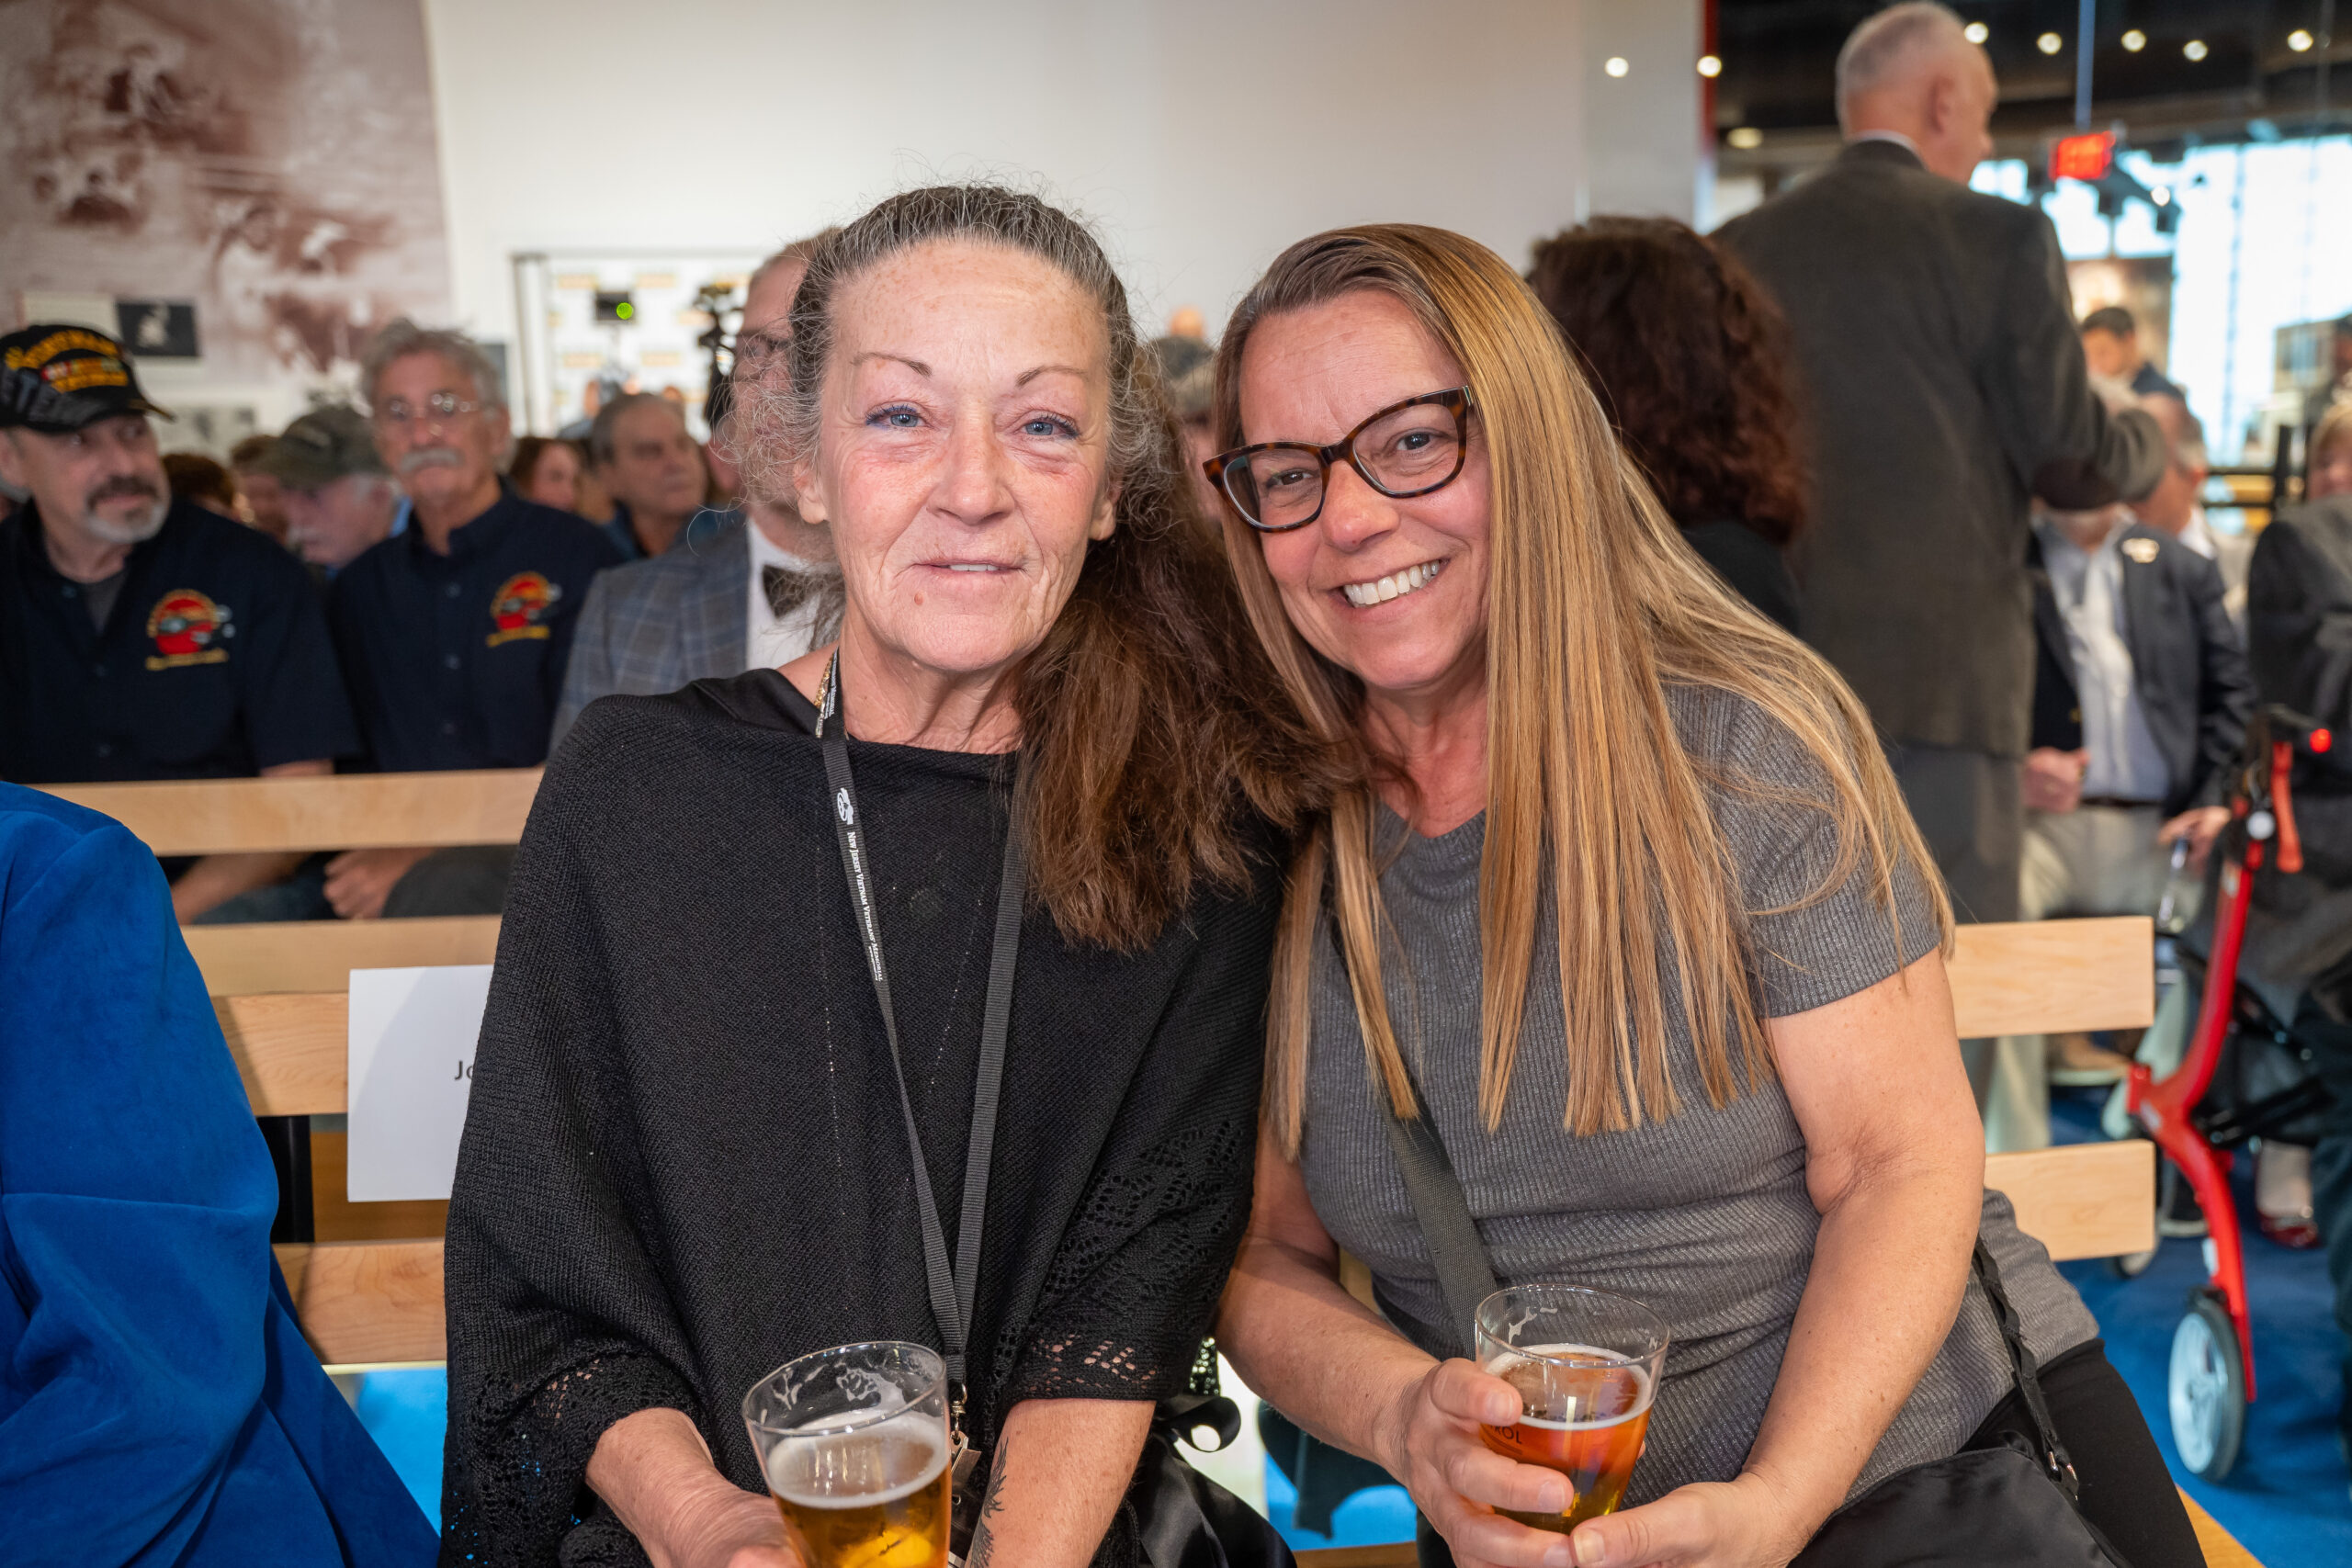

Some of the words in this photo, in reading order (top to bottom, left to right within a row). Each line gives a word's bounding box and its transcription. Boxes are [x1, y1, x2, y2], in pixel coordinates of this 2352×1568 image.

[849, 849, 861, 874] JERSEY
[855, 873, 868, 905] VIETNAM
[871, 942, 883, 982] MEMORIAL
